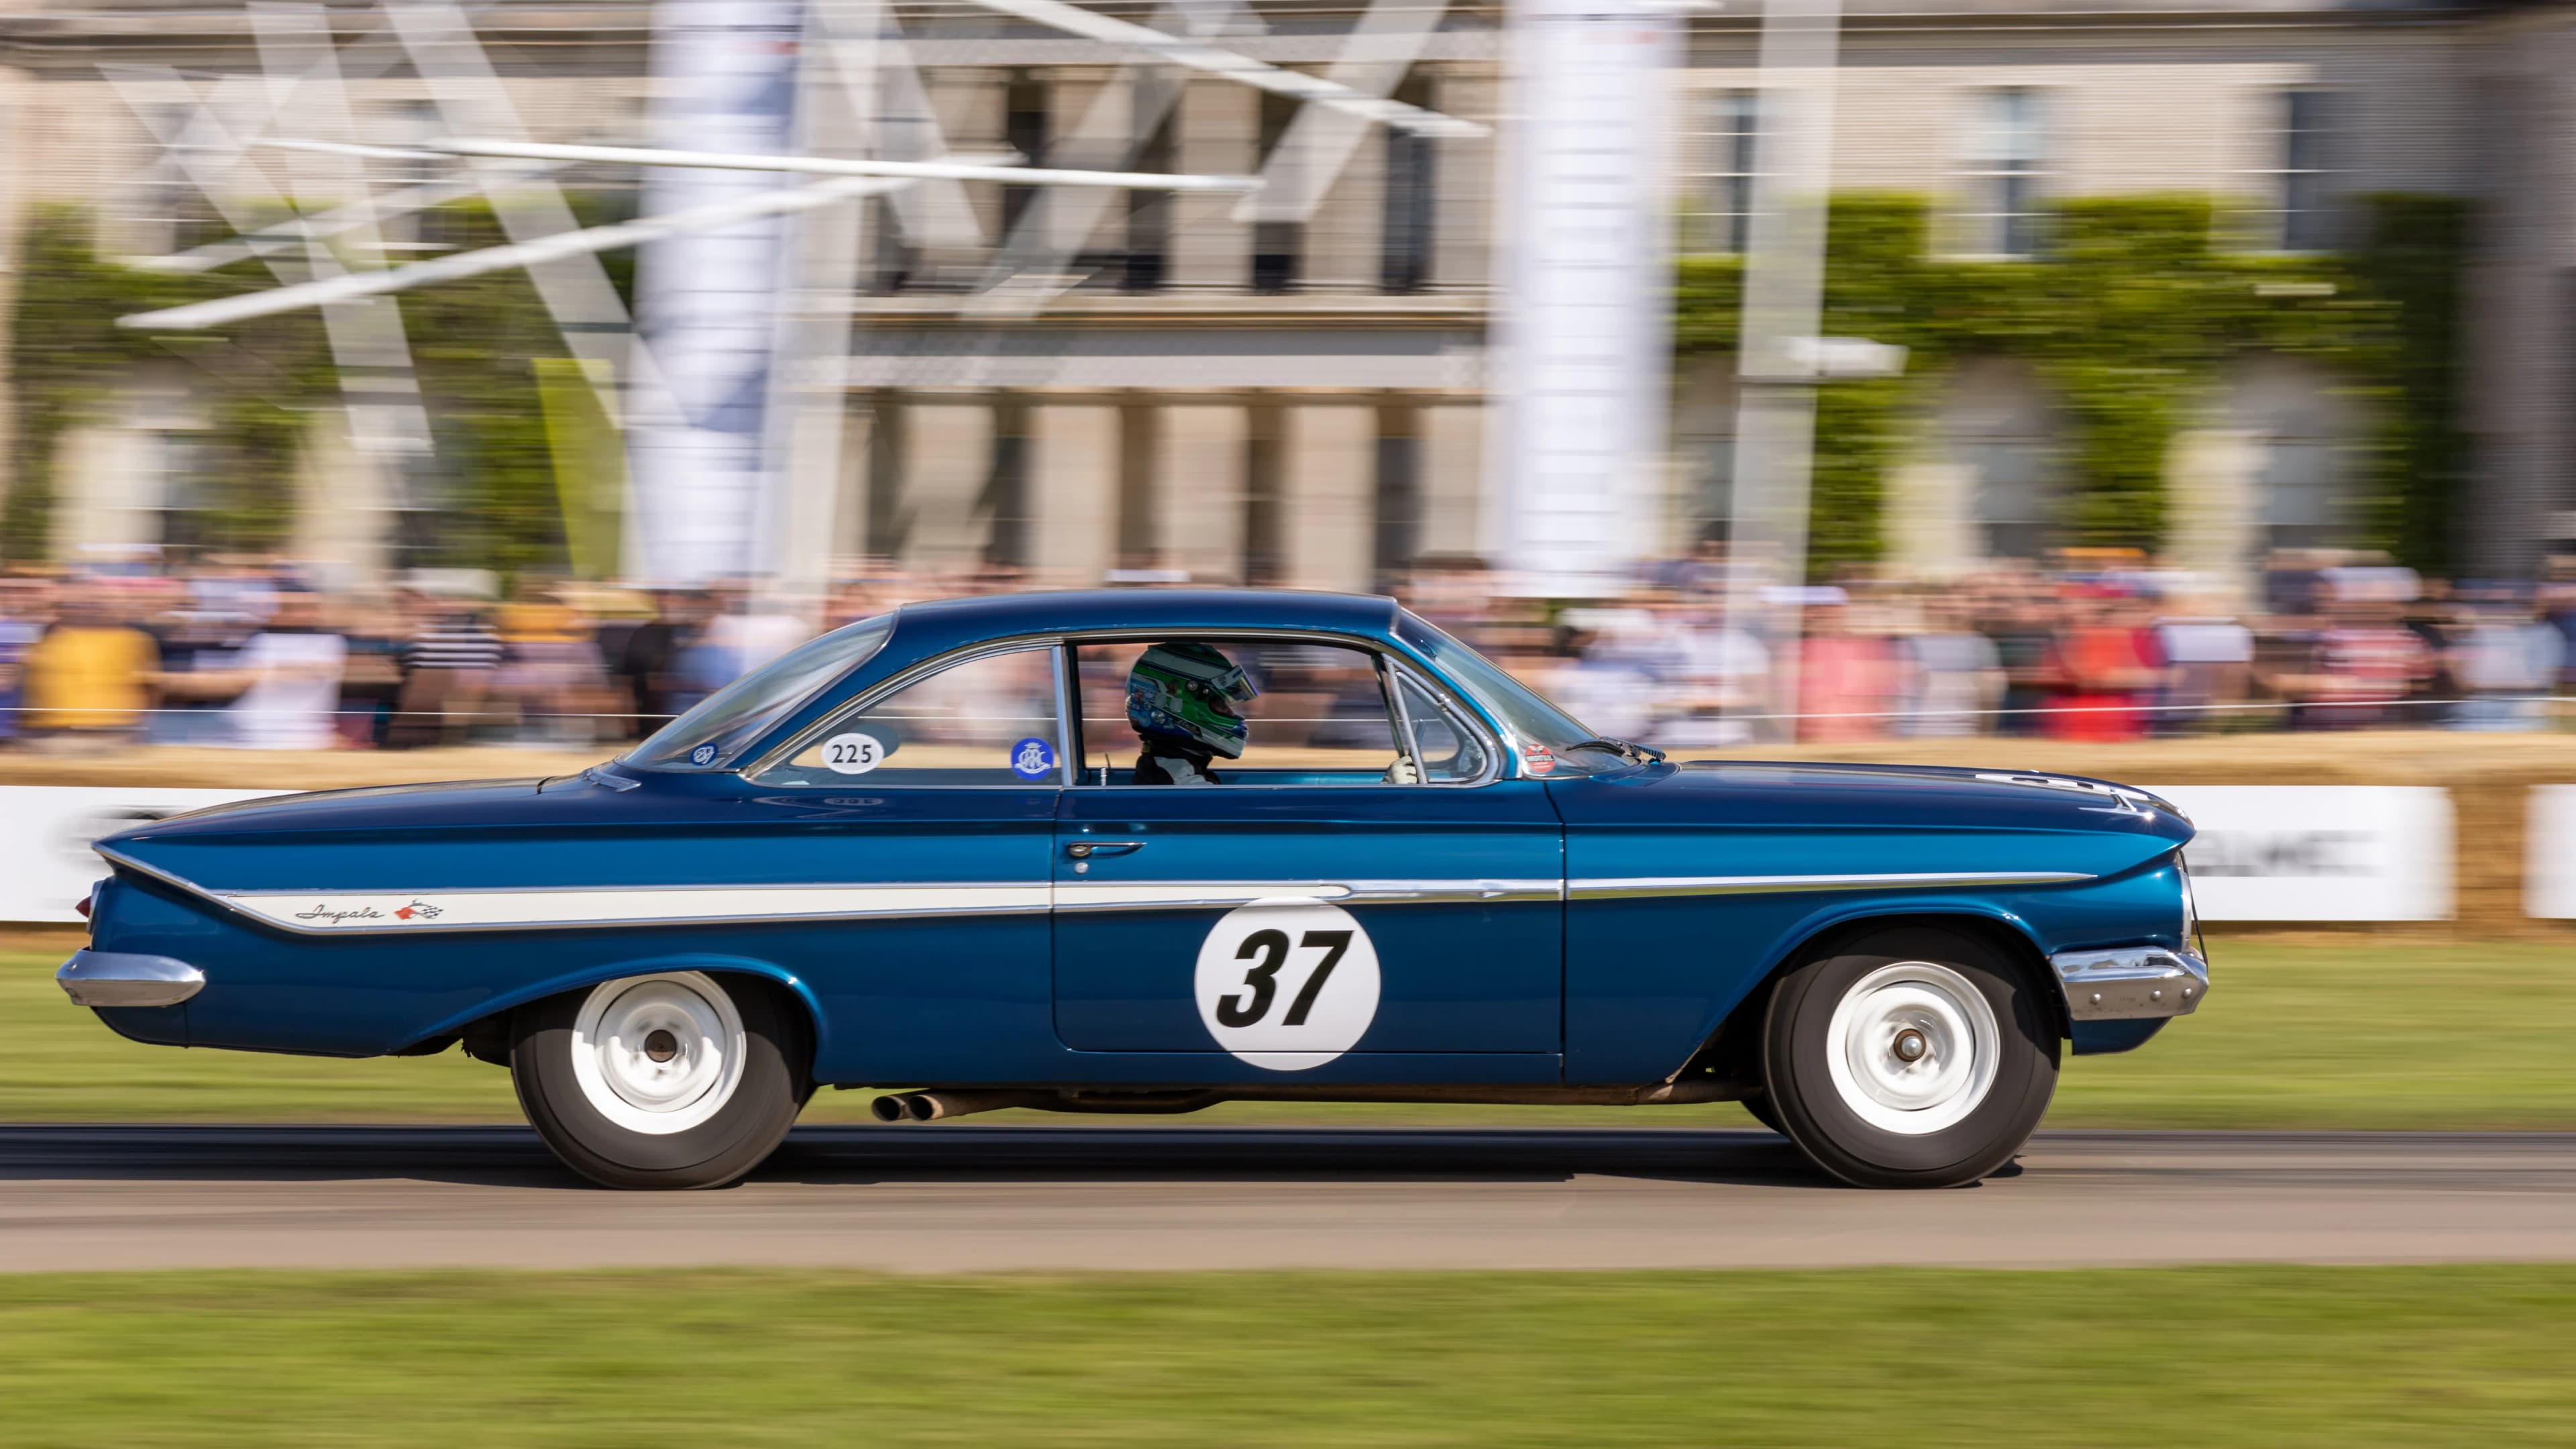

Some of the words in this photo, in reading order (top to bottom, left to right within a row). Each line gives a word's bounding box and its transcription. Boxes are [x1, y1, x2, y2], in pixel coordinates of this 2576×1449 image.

[831, 744, 873, 763] 225
[295, 904, 385, 924] Impala
[1216, 928, 1354, 1028] 37
